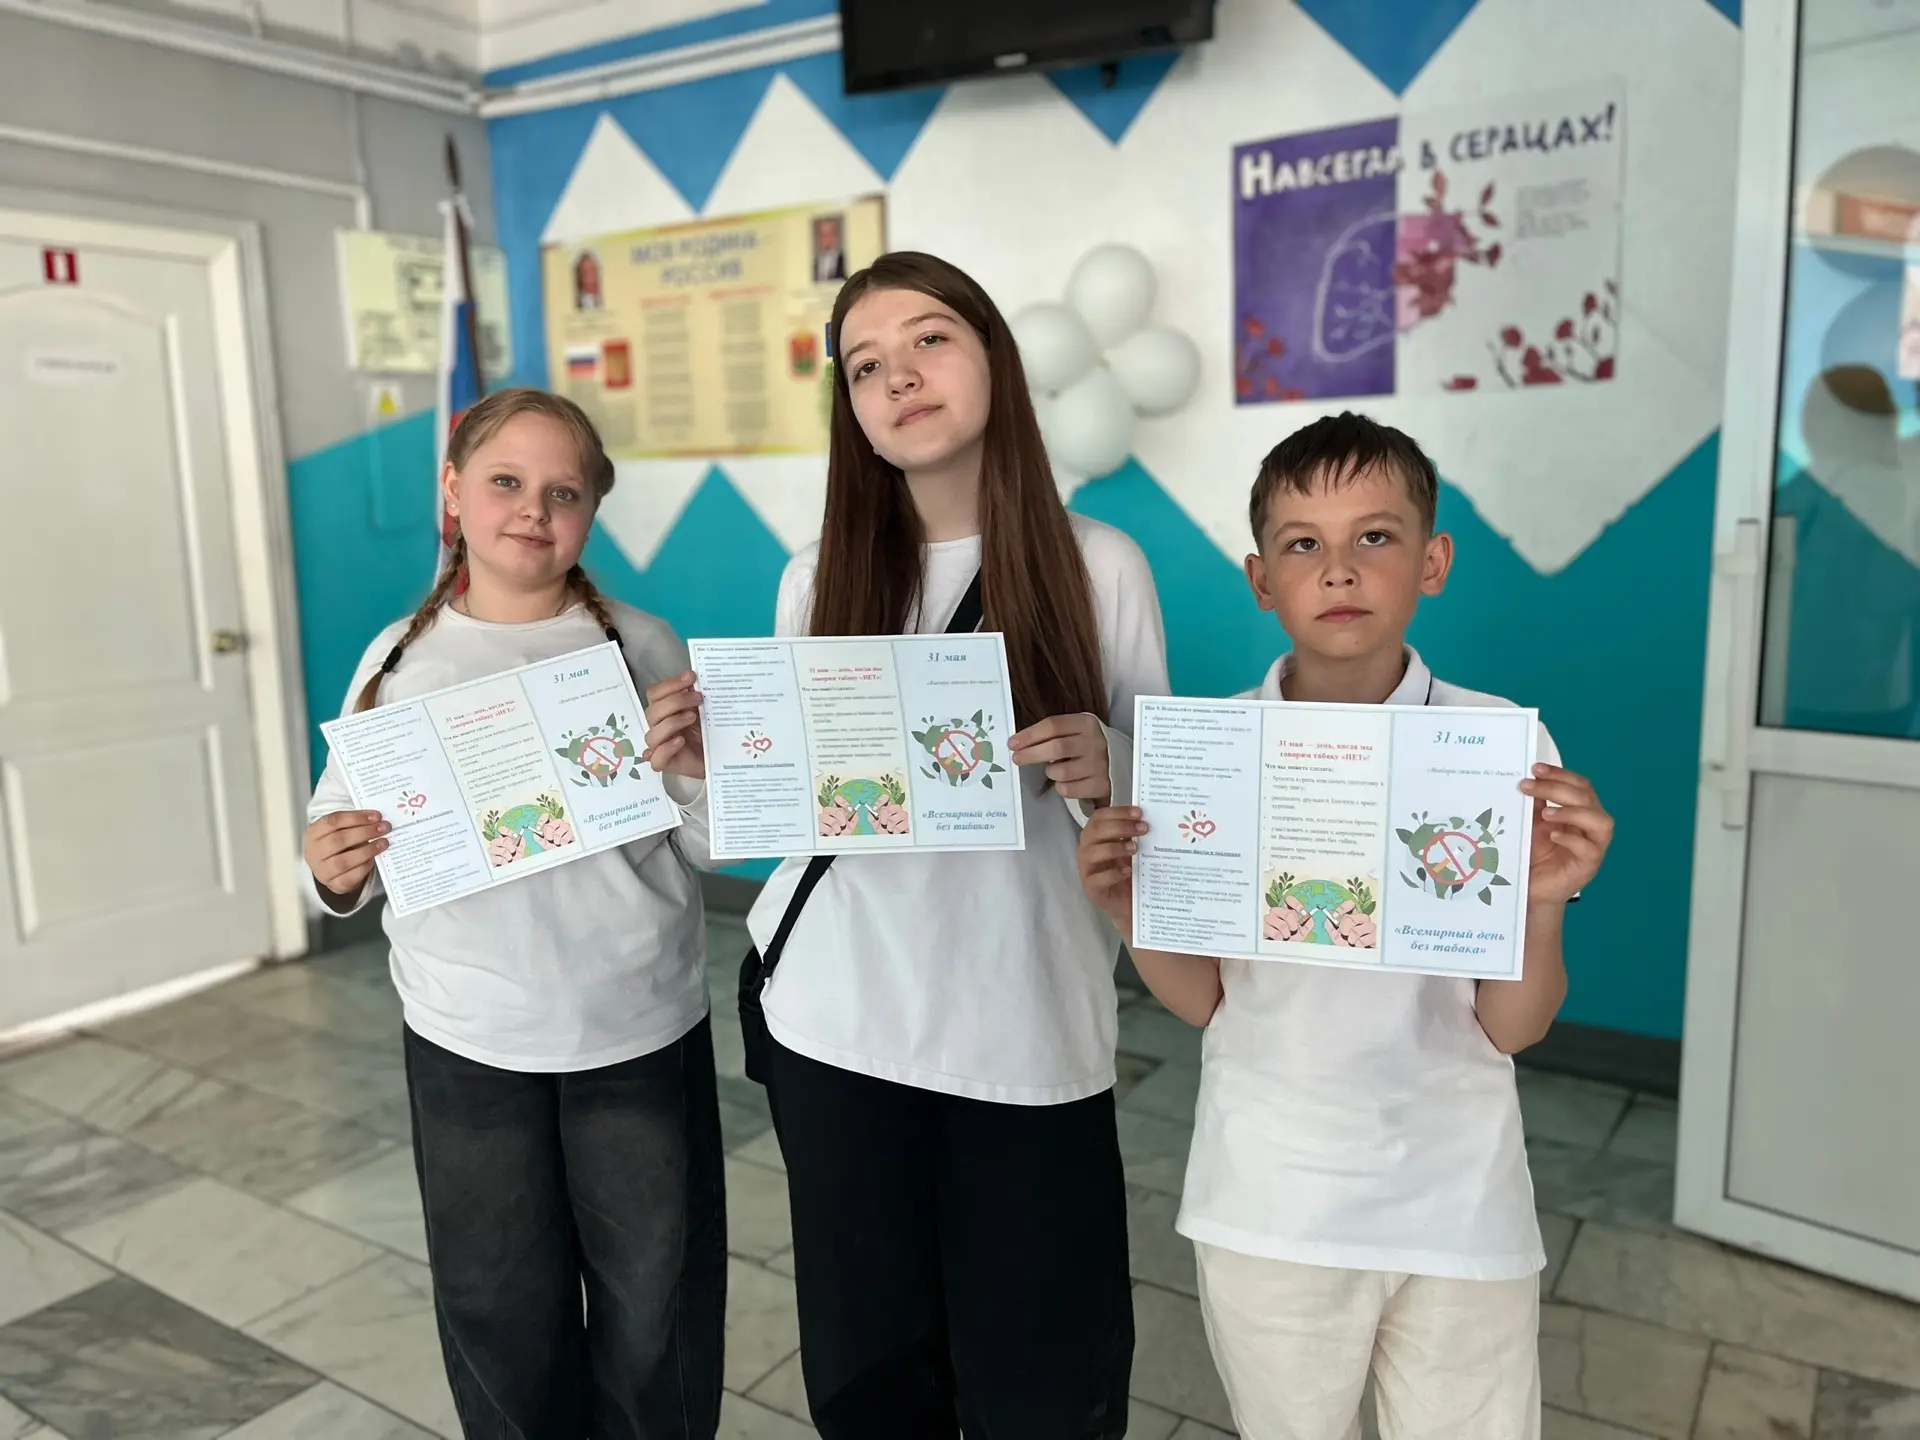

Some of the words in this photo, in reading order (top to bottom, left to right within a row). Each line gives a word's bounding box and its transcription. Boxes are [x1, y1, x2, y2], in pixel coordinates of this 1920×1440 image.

[1451, 102, 1617, 162] СЕРДЦАХ!
[927, 652, 940, 662] 31
[943, 654, 967, 662] мая
[553, 673, 564, 684] 31
[568, 668, 590, 680] мая
[1433, 731, 1451, 744] 31
[1454, 735, 1486, 745] мая
[1280, 752, 1312, 760] говорим
[1313, 753, 1339, 761] табаку
[583, 800, 638, 824] «Всемирный
[640, 796, 660, 806] день
[922, 810, 983, 820] «Всемирный
[985, 810, 1008, 818] день
[599, 822, 613, 831] без
[614, 810, 652, 826] табака»
[936, 822, 951, 831] без
[953, 822, 995, 830] табака»
[1394, 924, 1473, 939] «Всемирный
[1476, 930, 1505, 941] день
[1410, 940, 1429, 951] без
[1433, 943, 1487, 955] табака»
